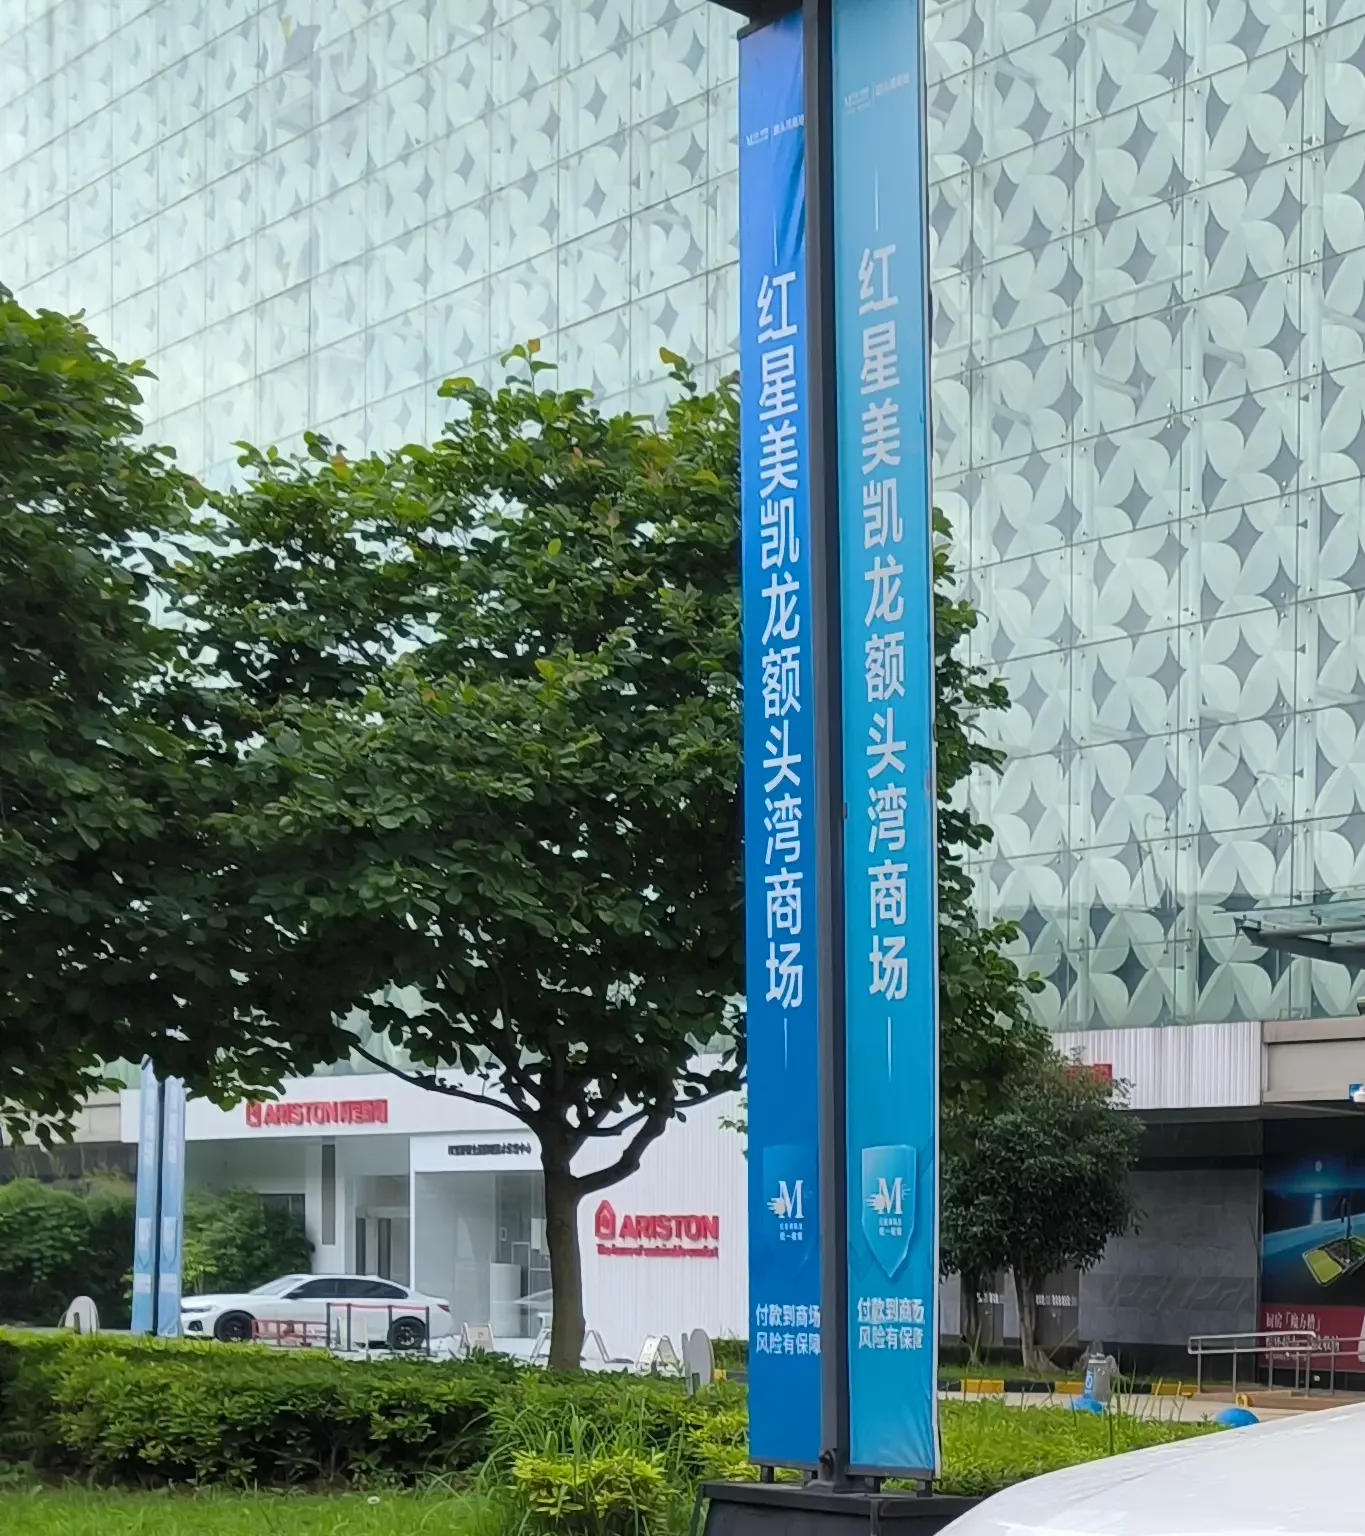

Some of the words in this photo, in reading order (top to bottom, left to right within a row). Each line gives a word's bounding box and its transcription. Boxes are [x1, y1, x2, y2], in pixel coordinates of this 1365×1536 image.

[757, 271, 804, 1010] 红星美凯龙额头湾商场
[857, 244, 909, 1002] 红星美凯龙额头湾商场
[619, 1214, 720, 1242] ARISTON
